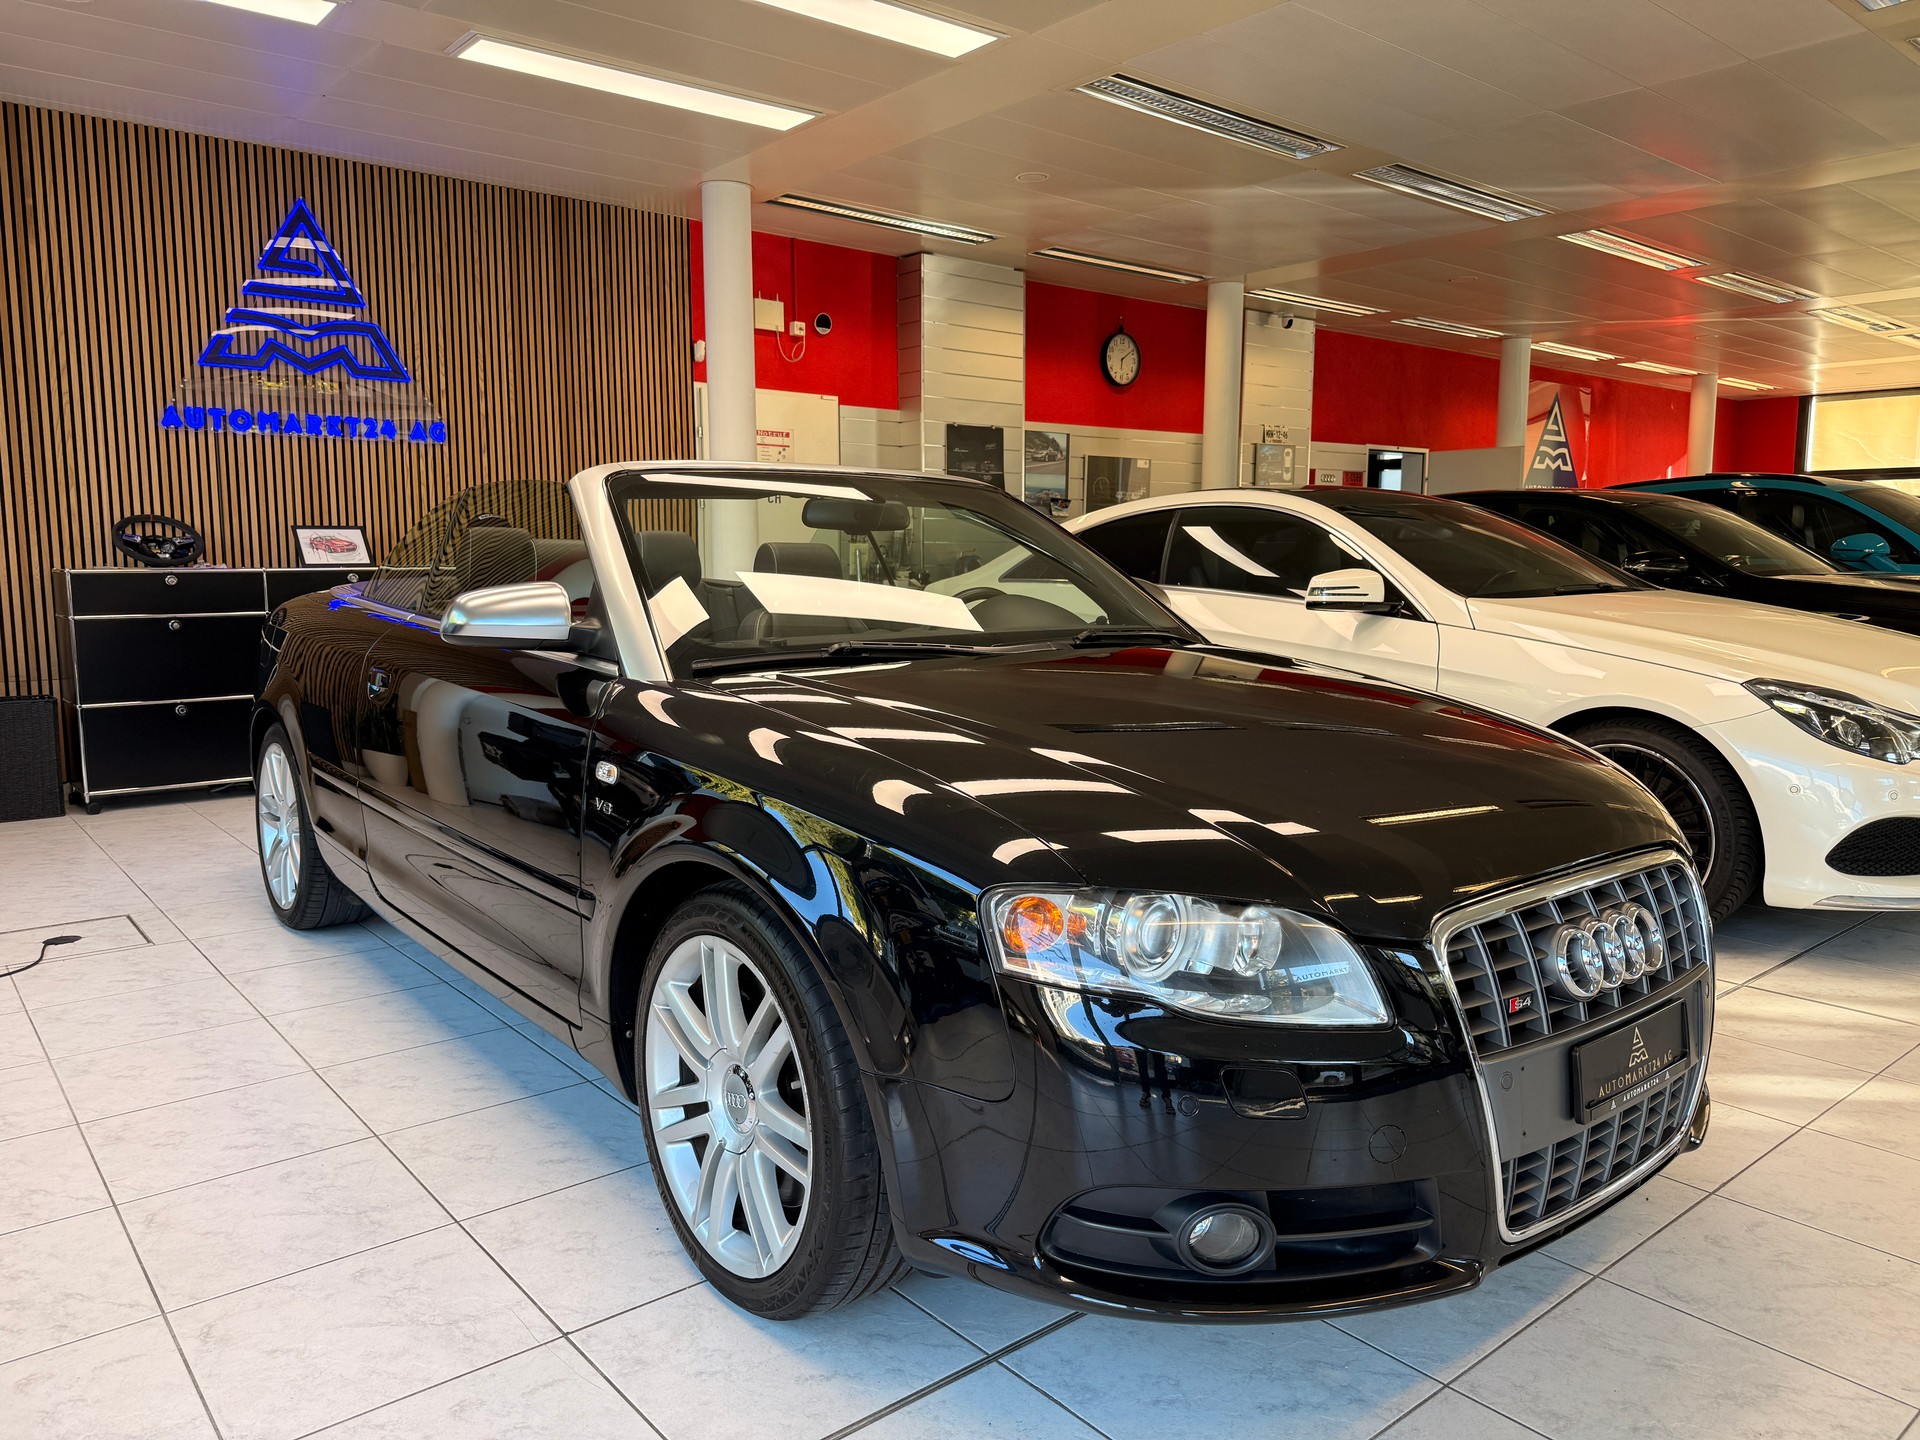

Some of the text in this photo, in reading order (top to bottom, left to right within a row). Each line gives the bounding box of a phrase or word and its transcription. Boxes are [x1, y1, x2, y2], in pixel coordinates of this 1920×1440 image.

[161, 405, 446, 443] AUTOMARKT24 AG
[1296, 967, 1349, 981] AUTOMARKT
[1514, 996, 1532, 1009] S4
[1598, 1049, 1673, 1098] AUTOMARKT24 AG
[1623, 1077, 1660, 1102] AUTOMARKT24
